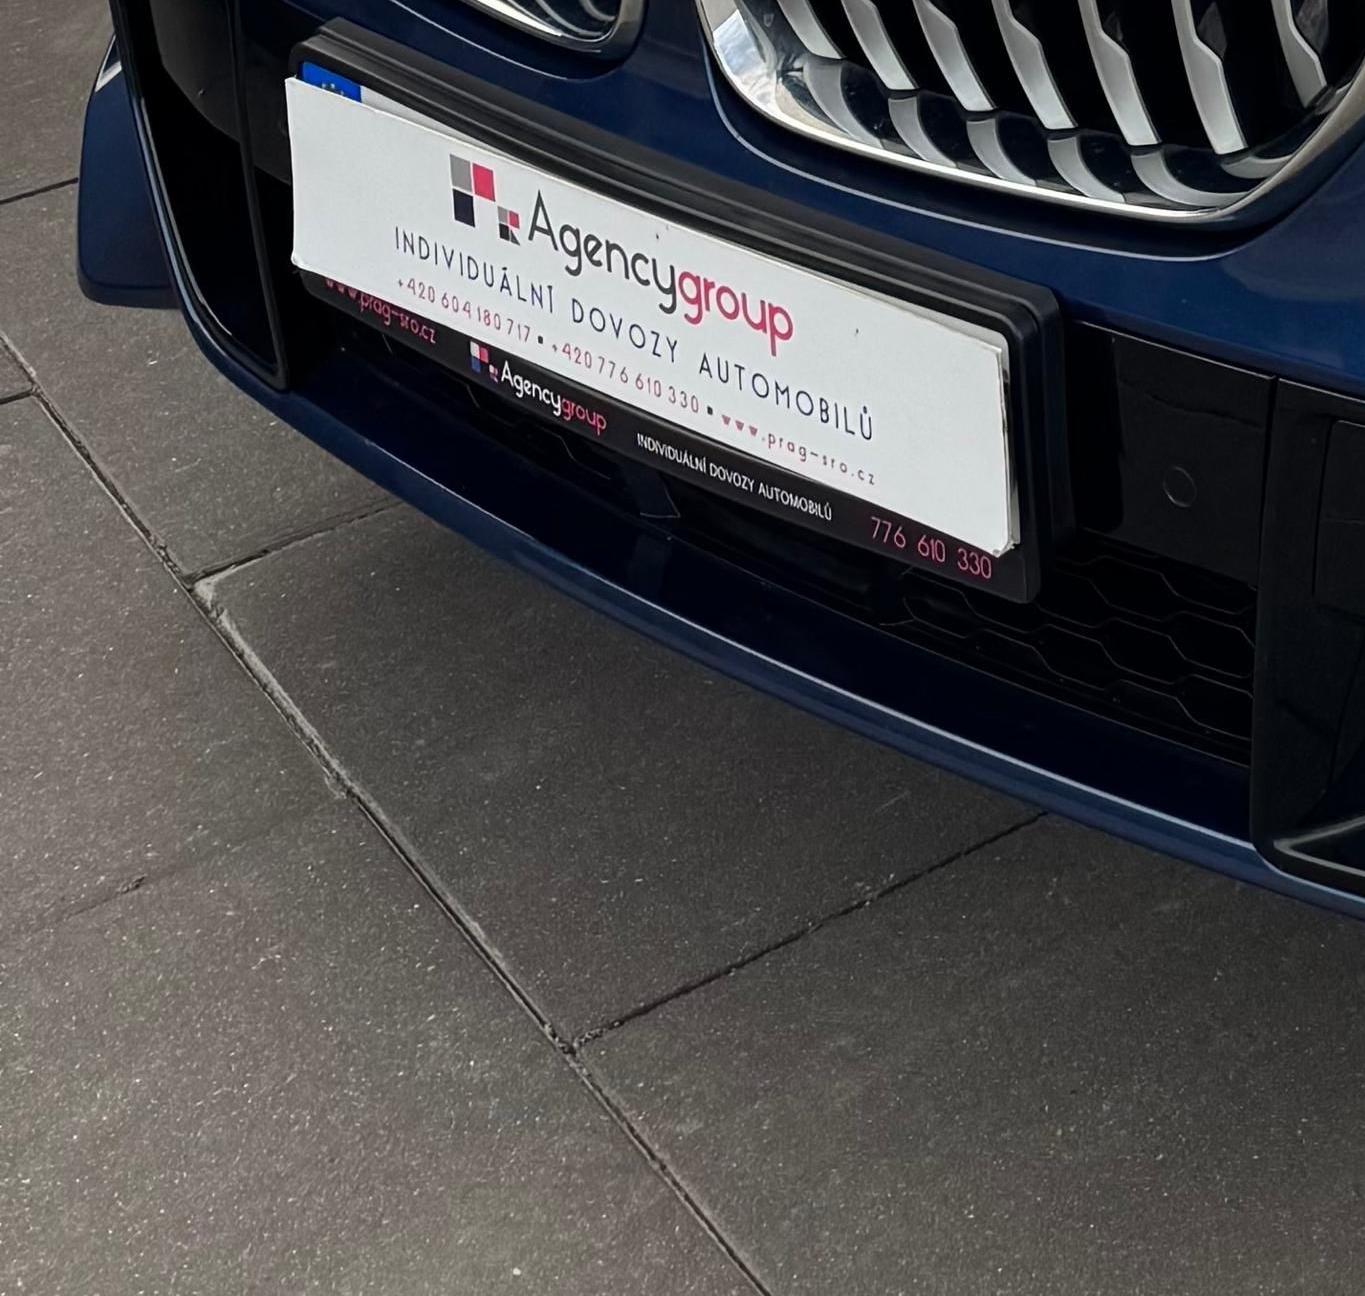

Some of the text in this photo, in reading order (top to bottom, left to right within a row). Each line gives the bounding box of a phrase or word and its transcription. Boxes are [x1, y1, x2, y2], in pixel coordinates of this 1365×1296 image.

[395, 226, 873, 441] INDIVIDUÁLNÍ DOVOZY AUTOMOBILŮ
[528, 189, 794, 357] Agencygroup
[476, 306, 502, 331] 180
[507, 318, 531, 343] 717
[598, 356, 629, 384] 776
[635, 376, 662, 398] 610
[668, 385, 700, 414] 330
[721, 414, 877, 486] www.prag-sro.cz
[501, 360, 608, 436] Agencygroup
[637, 432, 833, 522] INDIVIDUÁLNÍ DOVOZY AUTOMOBILŮ
[870, 515, 993, 579] 776 610 330
